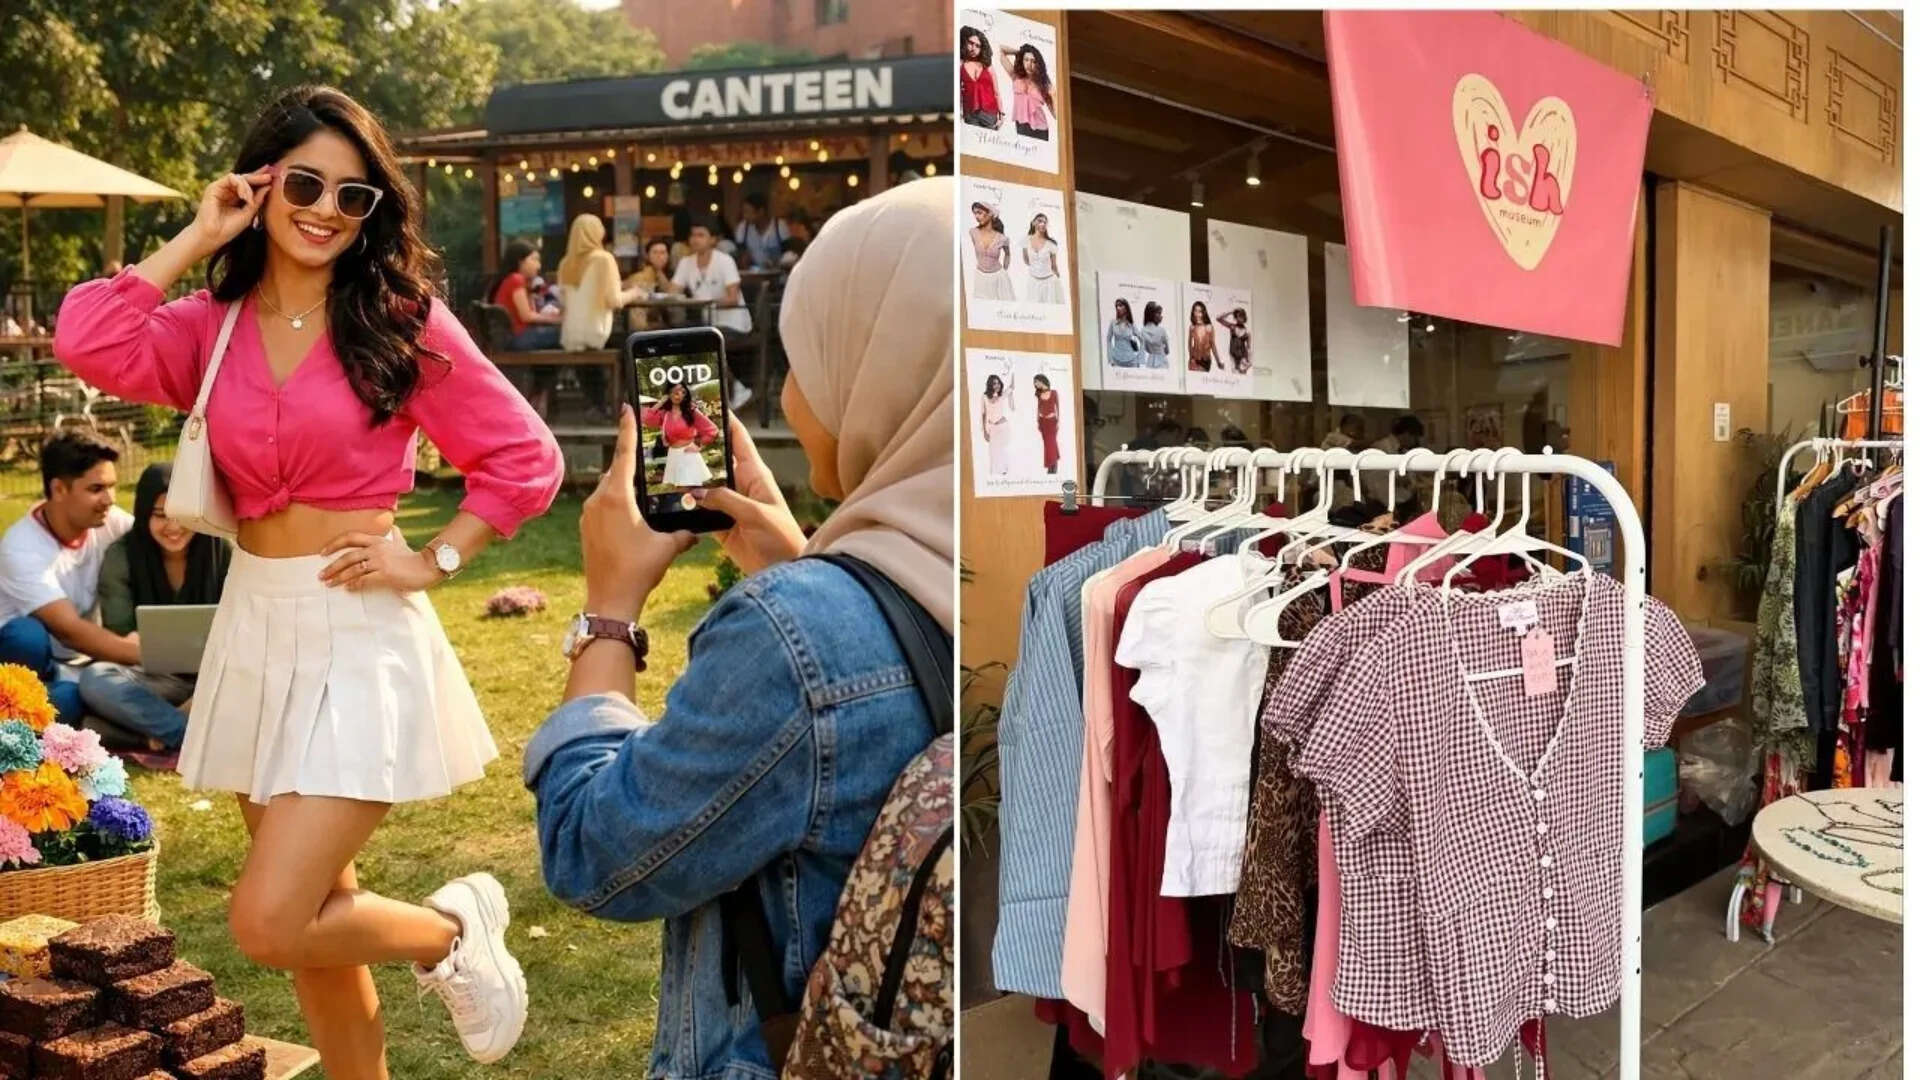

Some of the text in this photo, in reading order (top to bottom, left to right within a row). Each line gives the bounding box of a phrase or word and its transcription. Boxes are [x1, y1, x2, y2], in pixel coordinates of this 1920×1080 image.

[660, 66, 893, 120] CANTEEN
[1480, 124, 1564, 215] ish
[1499, 209, 1541, 227] museum
[649, 364, 712, 386] OOTD
